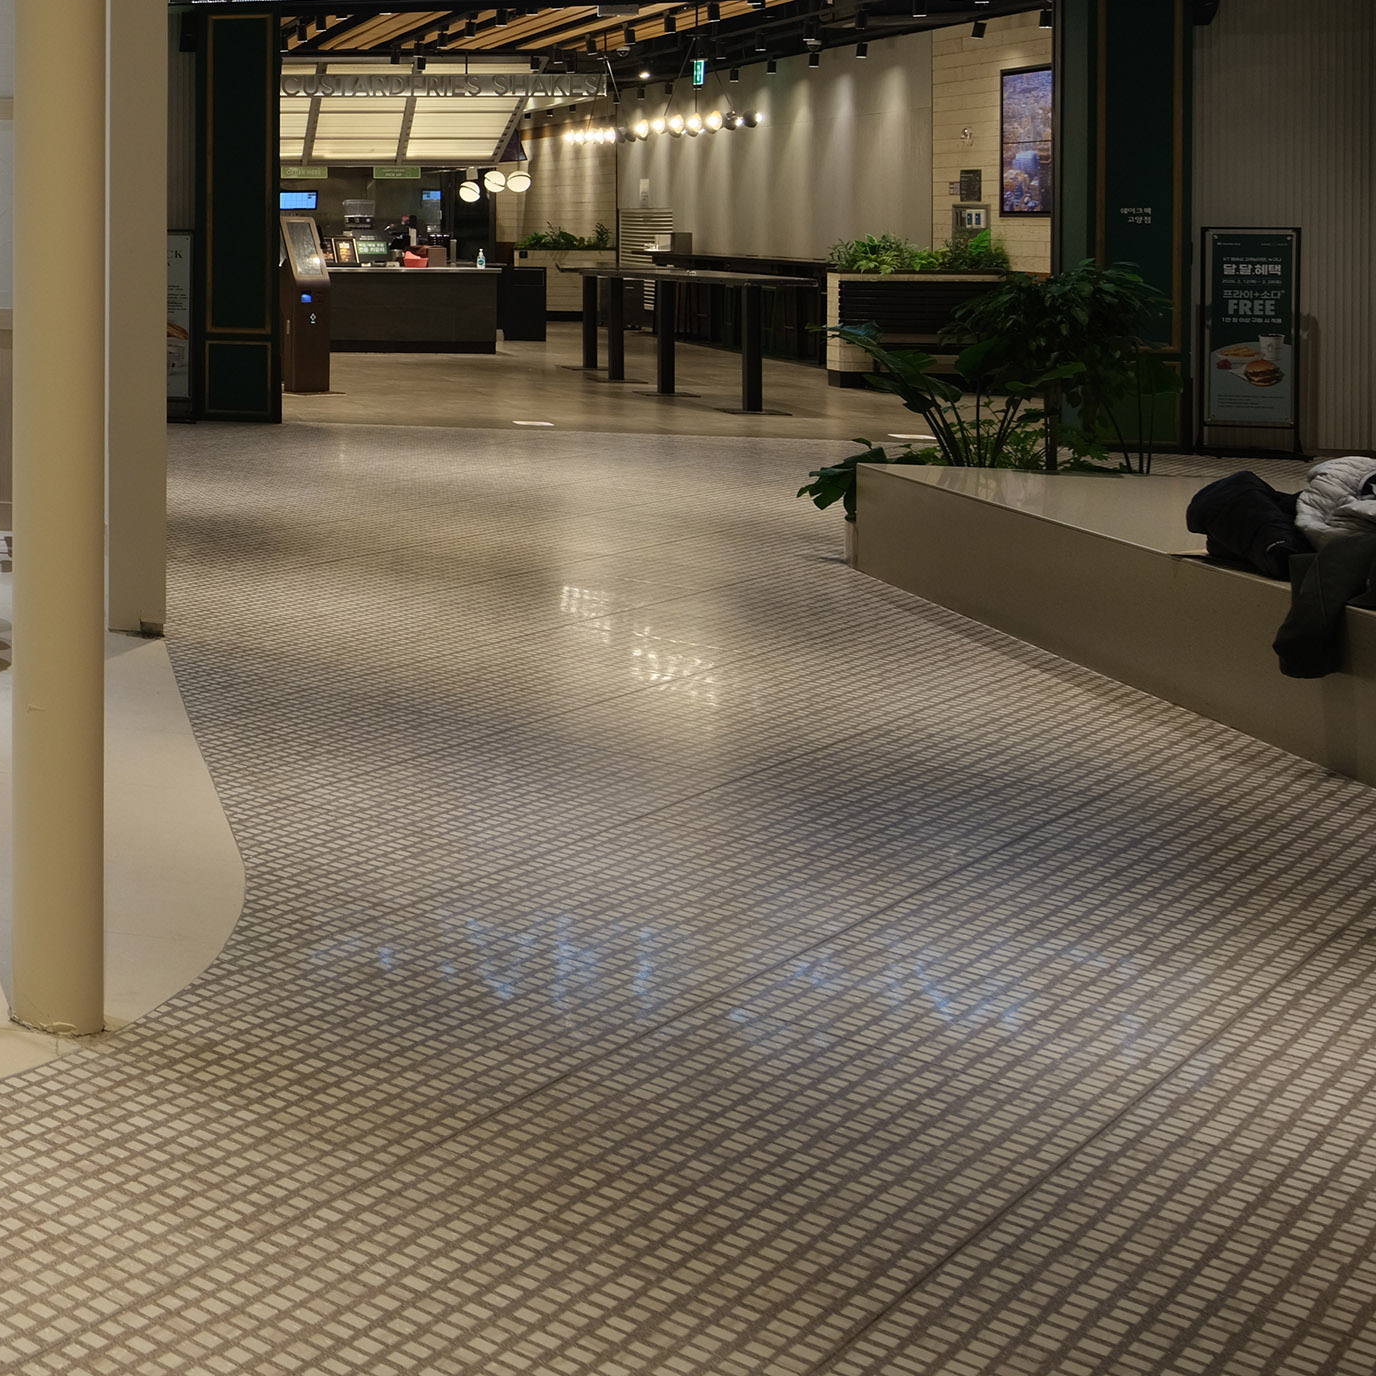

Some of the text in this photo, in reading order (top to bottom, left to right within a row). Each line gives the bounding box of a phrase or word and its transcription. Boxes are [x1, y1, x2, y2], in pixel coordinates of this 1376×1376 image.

[281, 73, 598, 96] CUSTARD FRIES SHAKES
[1223, 263, 1282, 275] 달.달.혜택
[1228, 299, 1275, 315] FREE
